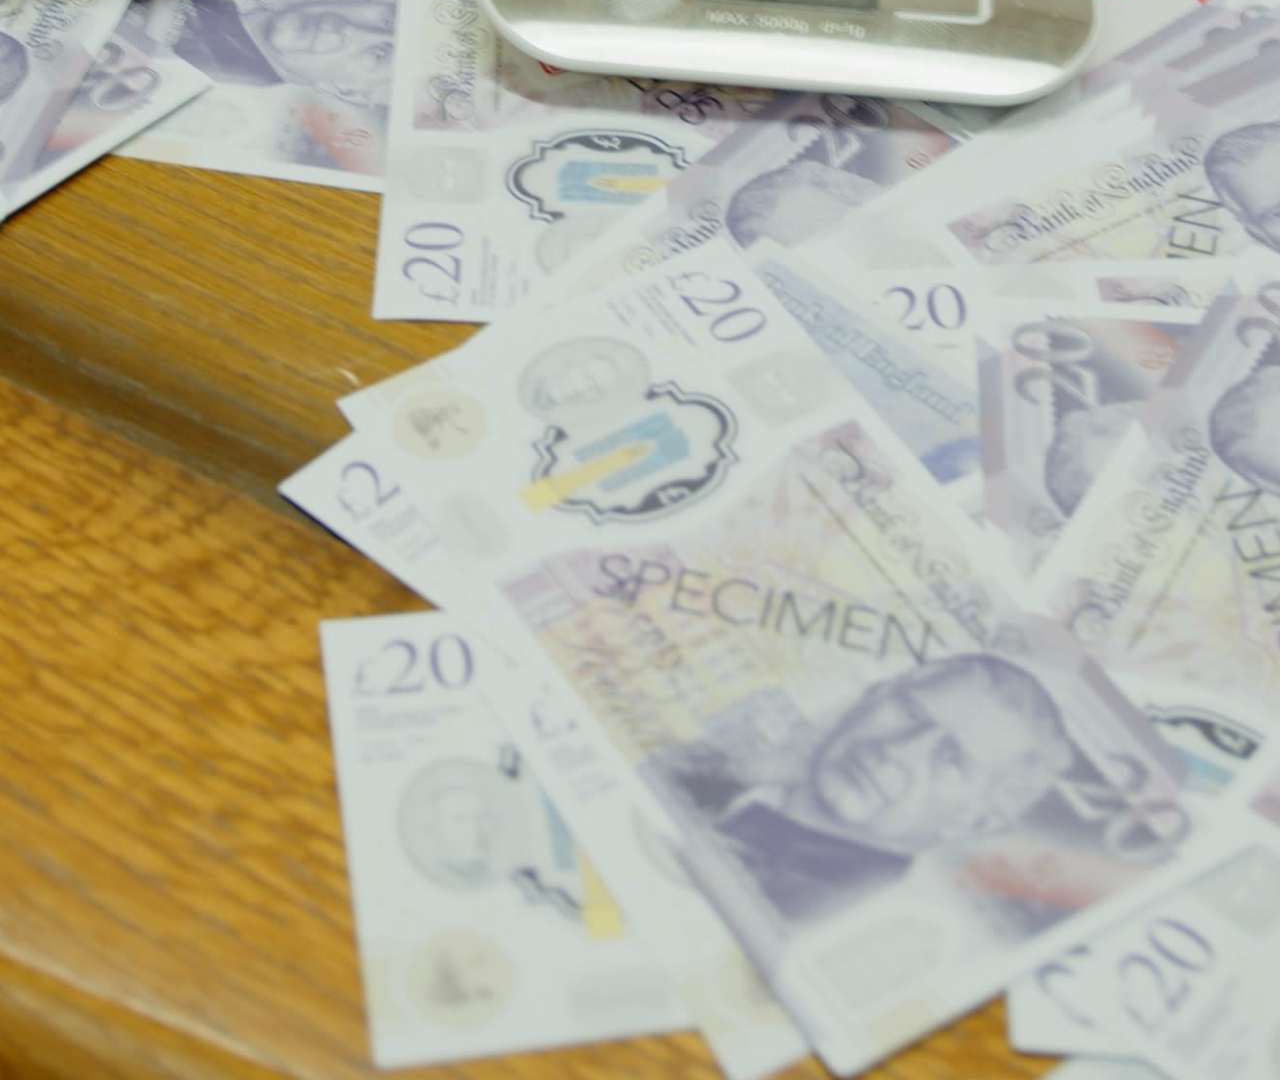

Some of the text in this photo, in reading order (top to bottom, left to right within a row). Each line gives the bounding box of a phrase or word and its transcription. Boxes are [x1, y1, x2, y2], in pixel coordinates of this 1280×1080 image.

[402, 222, 465, 308] £20
[670, 270, 768, 342] £20
[337, 460, 400, 522] £2
[592, 554, 945, 667] SPECIMEN
[354, 634, 473, 697] £20
